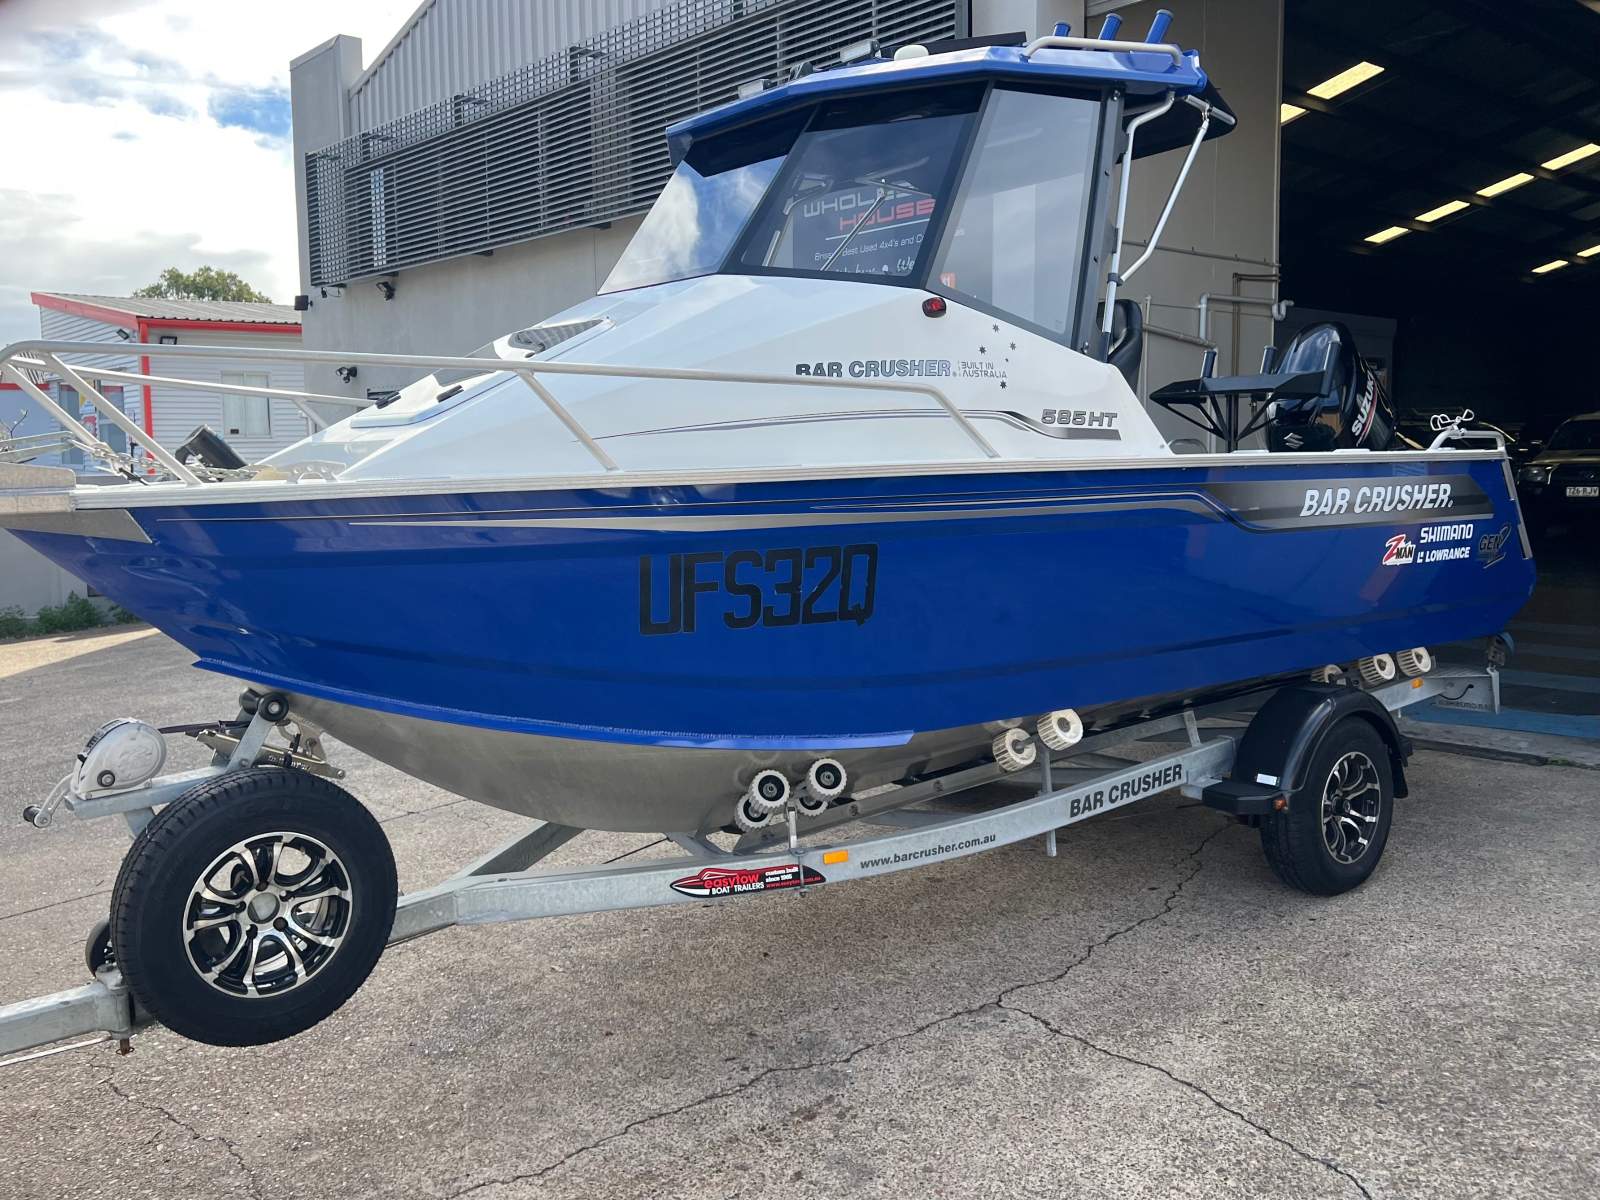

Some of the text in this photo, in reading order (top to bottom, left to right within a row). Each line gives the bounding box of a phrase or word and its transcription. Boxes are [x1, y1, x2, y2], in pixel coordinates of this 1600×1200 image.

[901, 235, 915, 247] and
[796, 361, 843, 378] BAR
[961, 361, 995, 371] BUILT IN
[962, 369, 1009, 379] AUSTRALIA
[1041, 408, 1118, 428] 585HT
[1300, 487, 1351, 518] BAR
[1420, 523, 1474, 544] SHIMANO
[1426, 546, 1472, 563] LOWRANCE
[1069, 763, 1183, 818] BAR CRUSHER
[860, 834, 997, 870] www.barcrusher.com.au
[704, 872, 760, 889] easytow
[712, 881, 765, 896] BOAT TRAILERS
